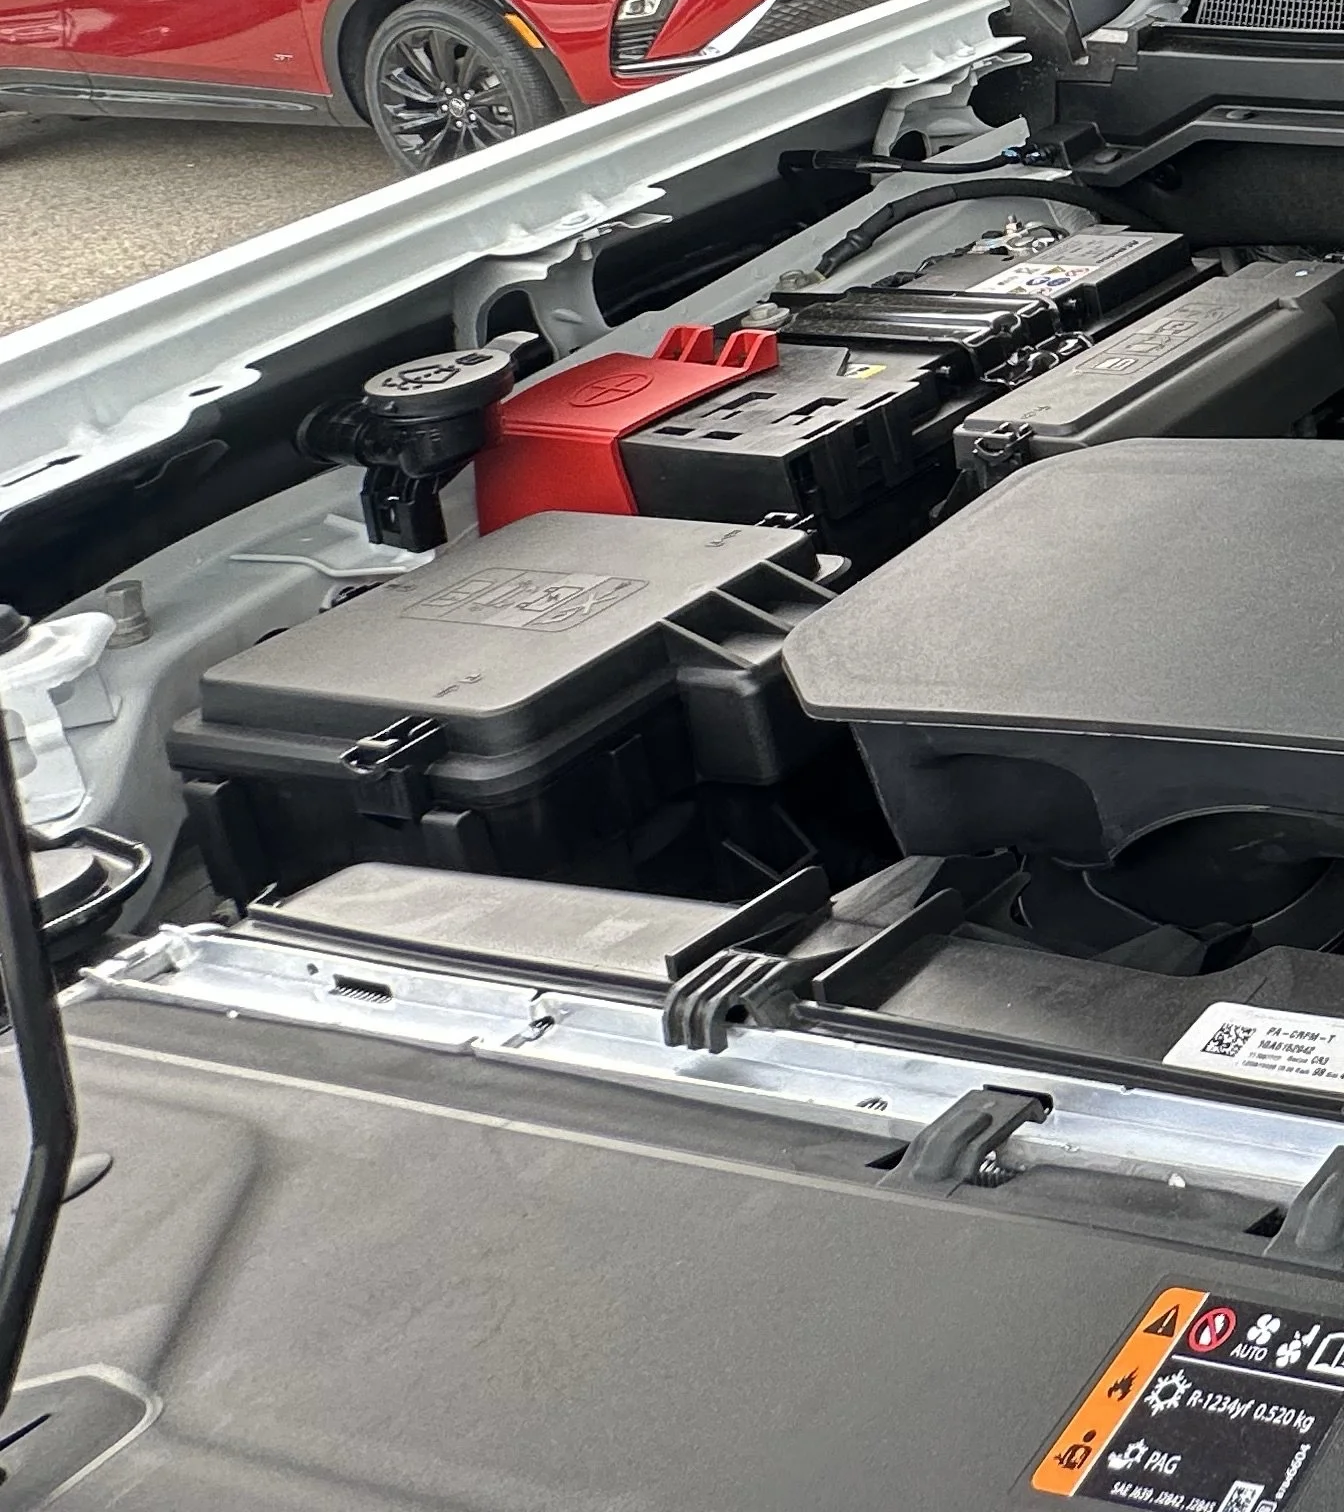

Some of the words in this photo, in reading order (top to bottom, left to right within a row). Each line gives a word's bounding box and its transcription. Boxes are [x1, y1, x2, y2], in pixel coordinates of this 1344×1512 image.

[1230, 1343, 1268, 1361] AUTO
[1187, 1392, 1253, 1419] R-1234yf
[1253, 1402, 1295, 1427] 0.520
[1293, 1409, 1317, 1434] kg
[1144, 1451, 1182, 1475] PAG
[1110, 1481, 1134, 1498] SAE
